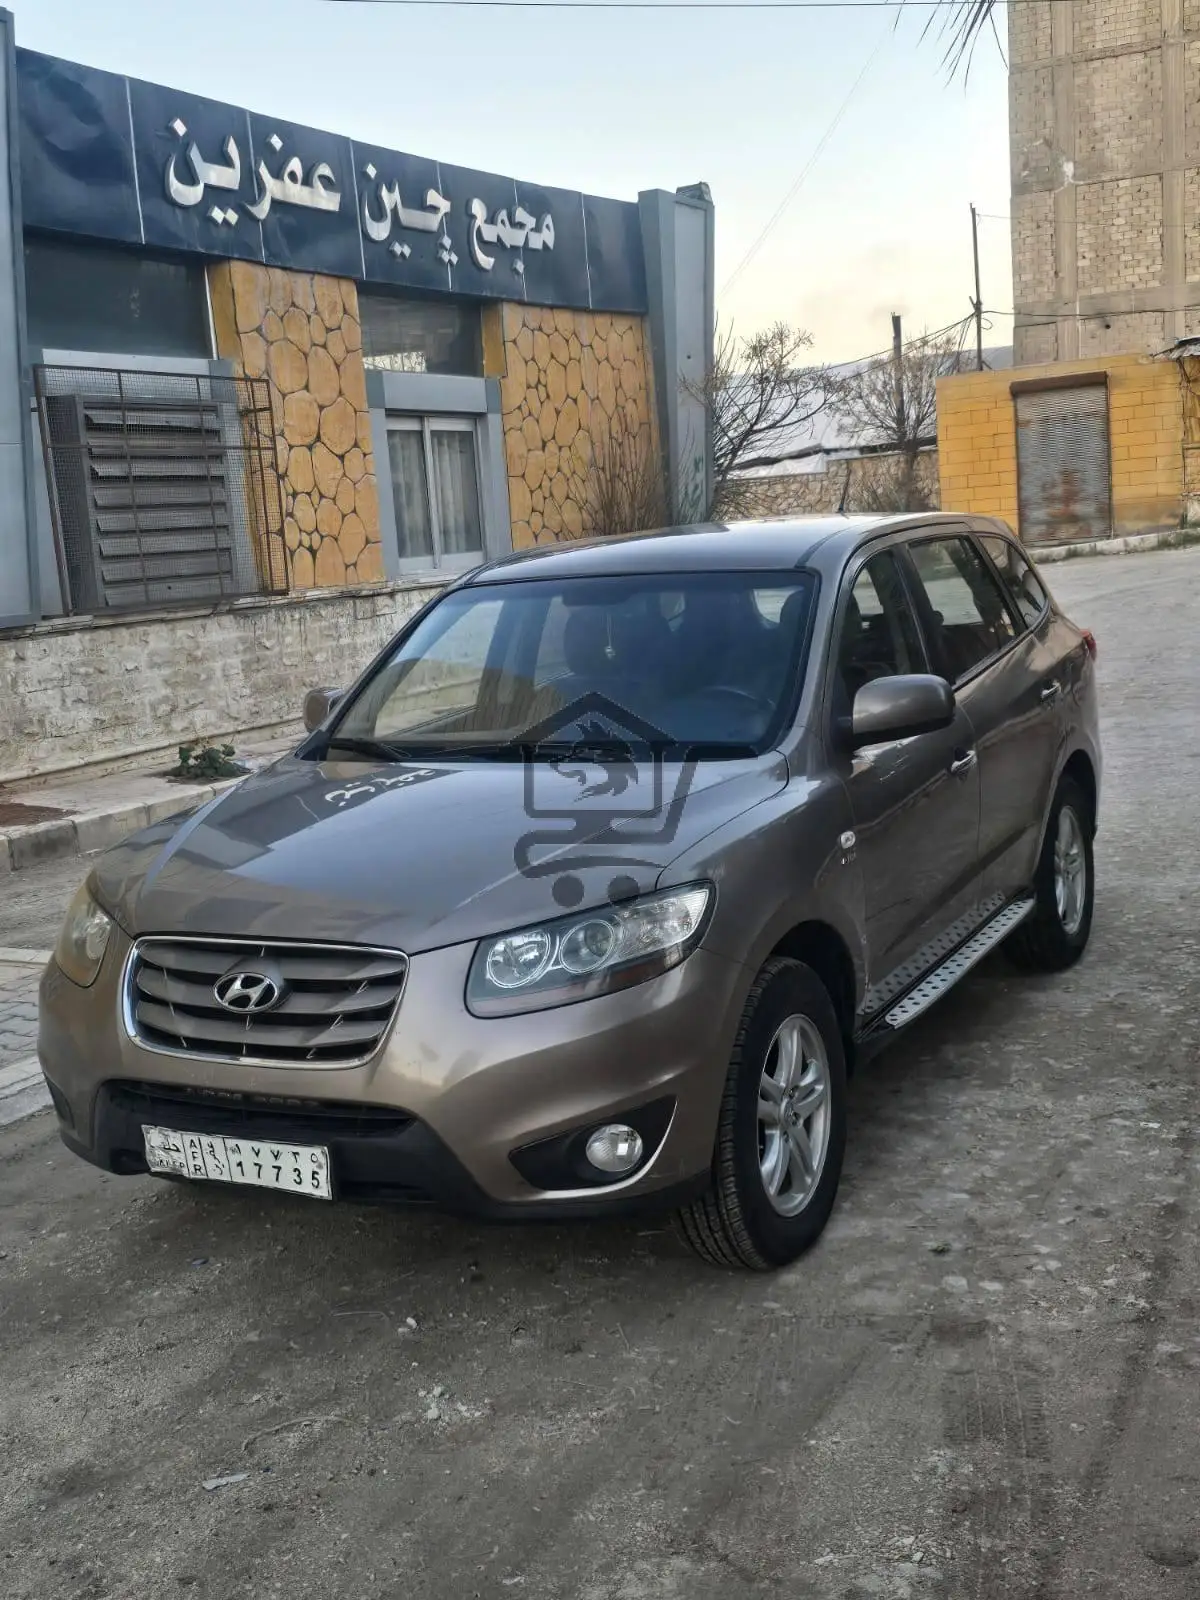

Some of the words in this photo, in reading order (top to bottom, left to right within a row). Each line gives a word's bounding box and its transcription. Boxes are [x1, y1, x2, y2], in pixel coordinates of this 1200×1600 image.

[165, 118, 341, 227] عفرين
[466, 198, 556, 275] مجمع
[235, 1160, 321, 1189] 17735
